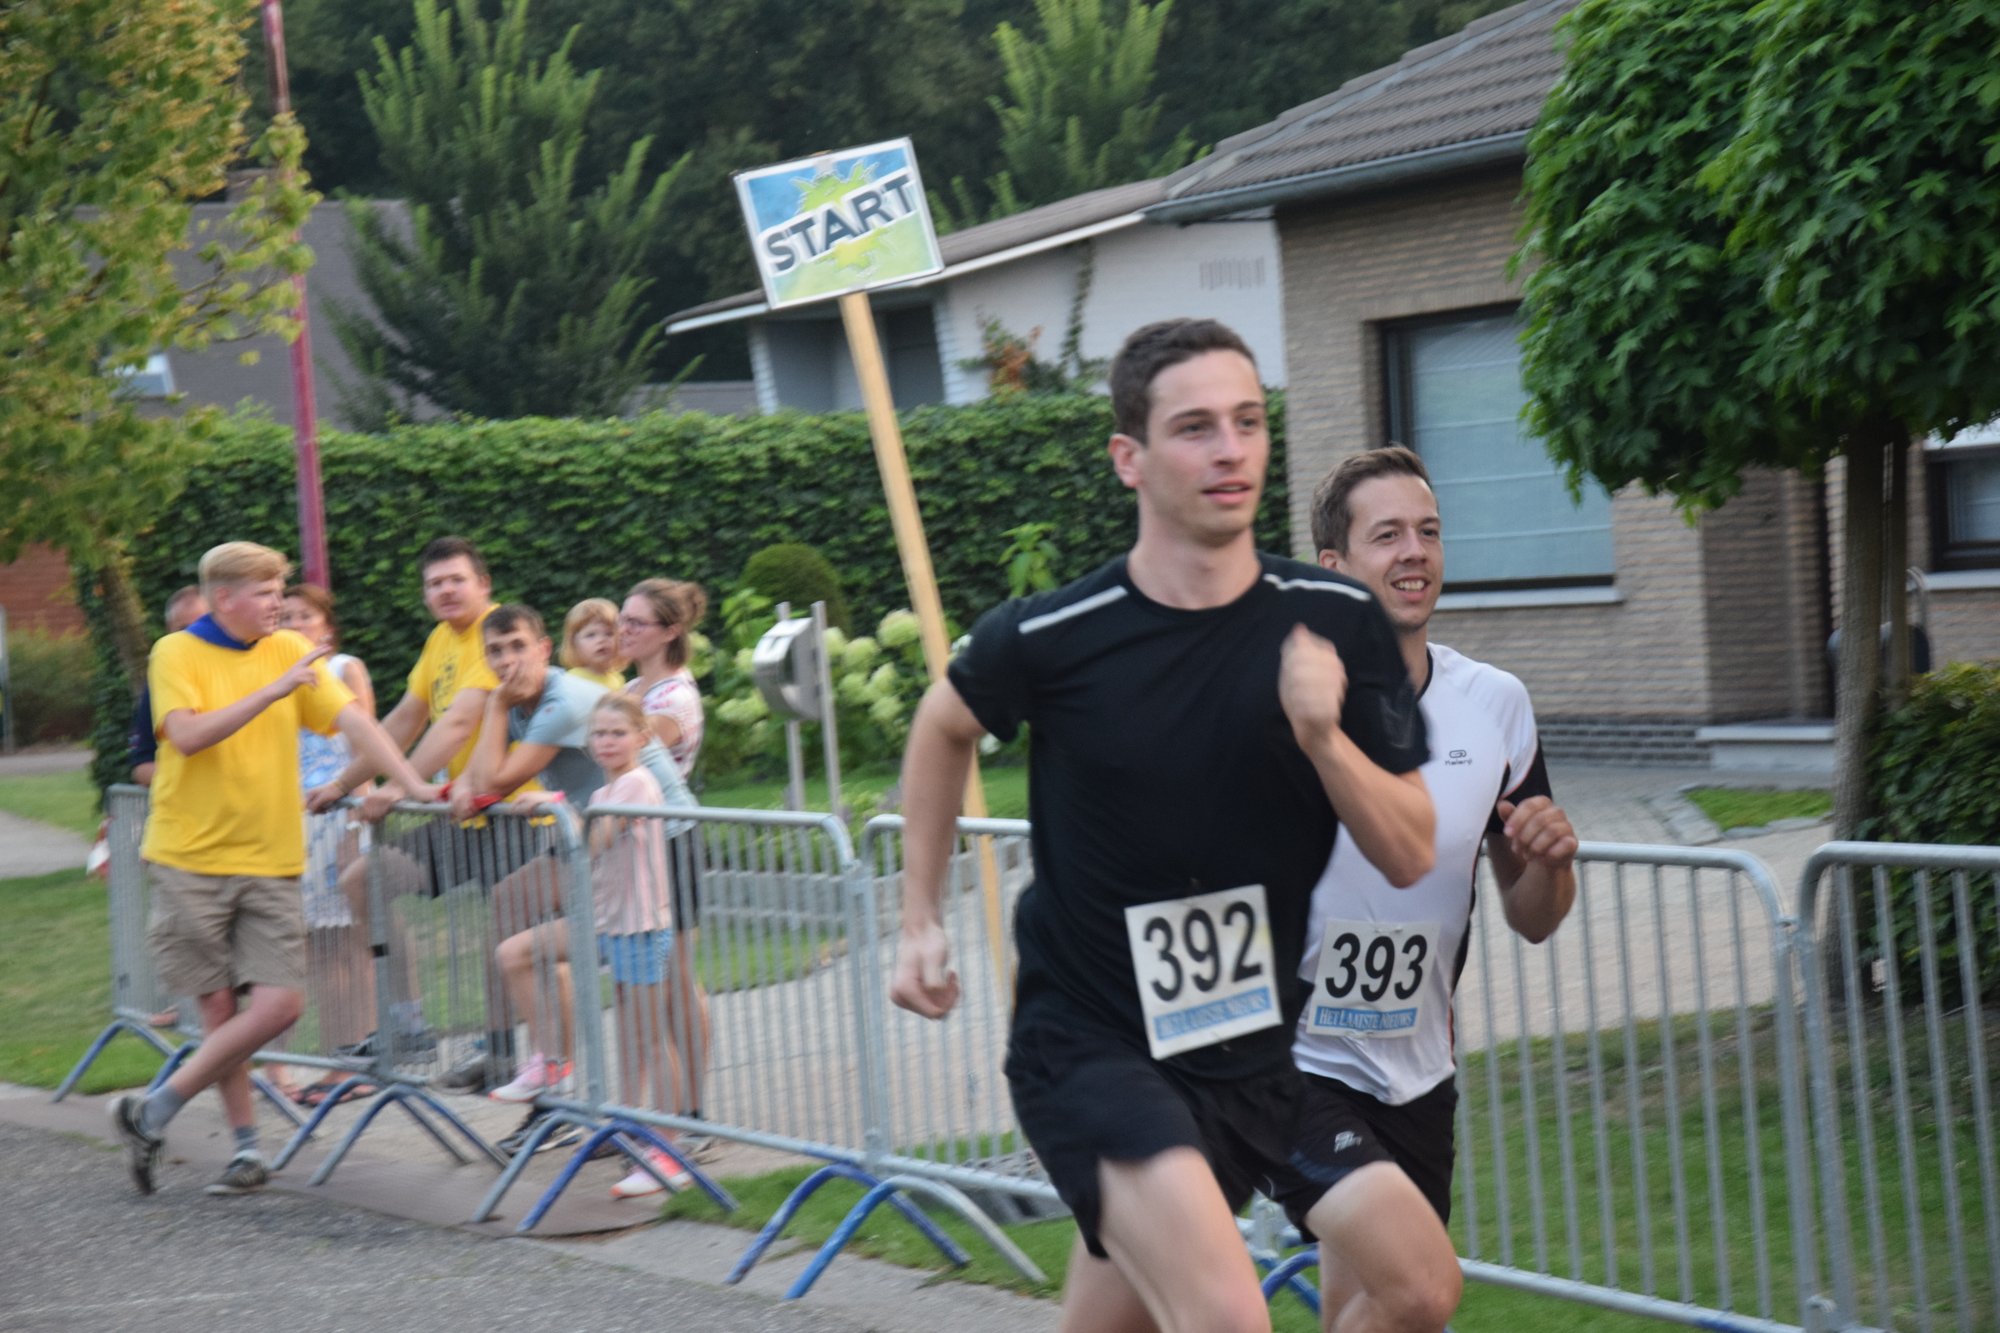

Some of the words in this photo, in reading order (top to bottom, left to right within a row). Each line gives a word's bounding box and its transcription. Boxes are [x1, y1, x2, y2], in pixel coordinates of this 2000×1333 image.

[766, 174, 911, 271] START
[1143, 901, 1262, 1002] 392
[1325, 932, 1428, 1003] 393
